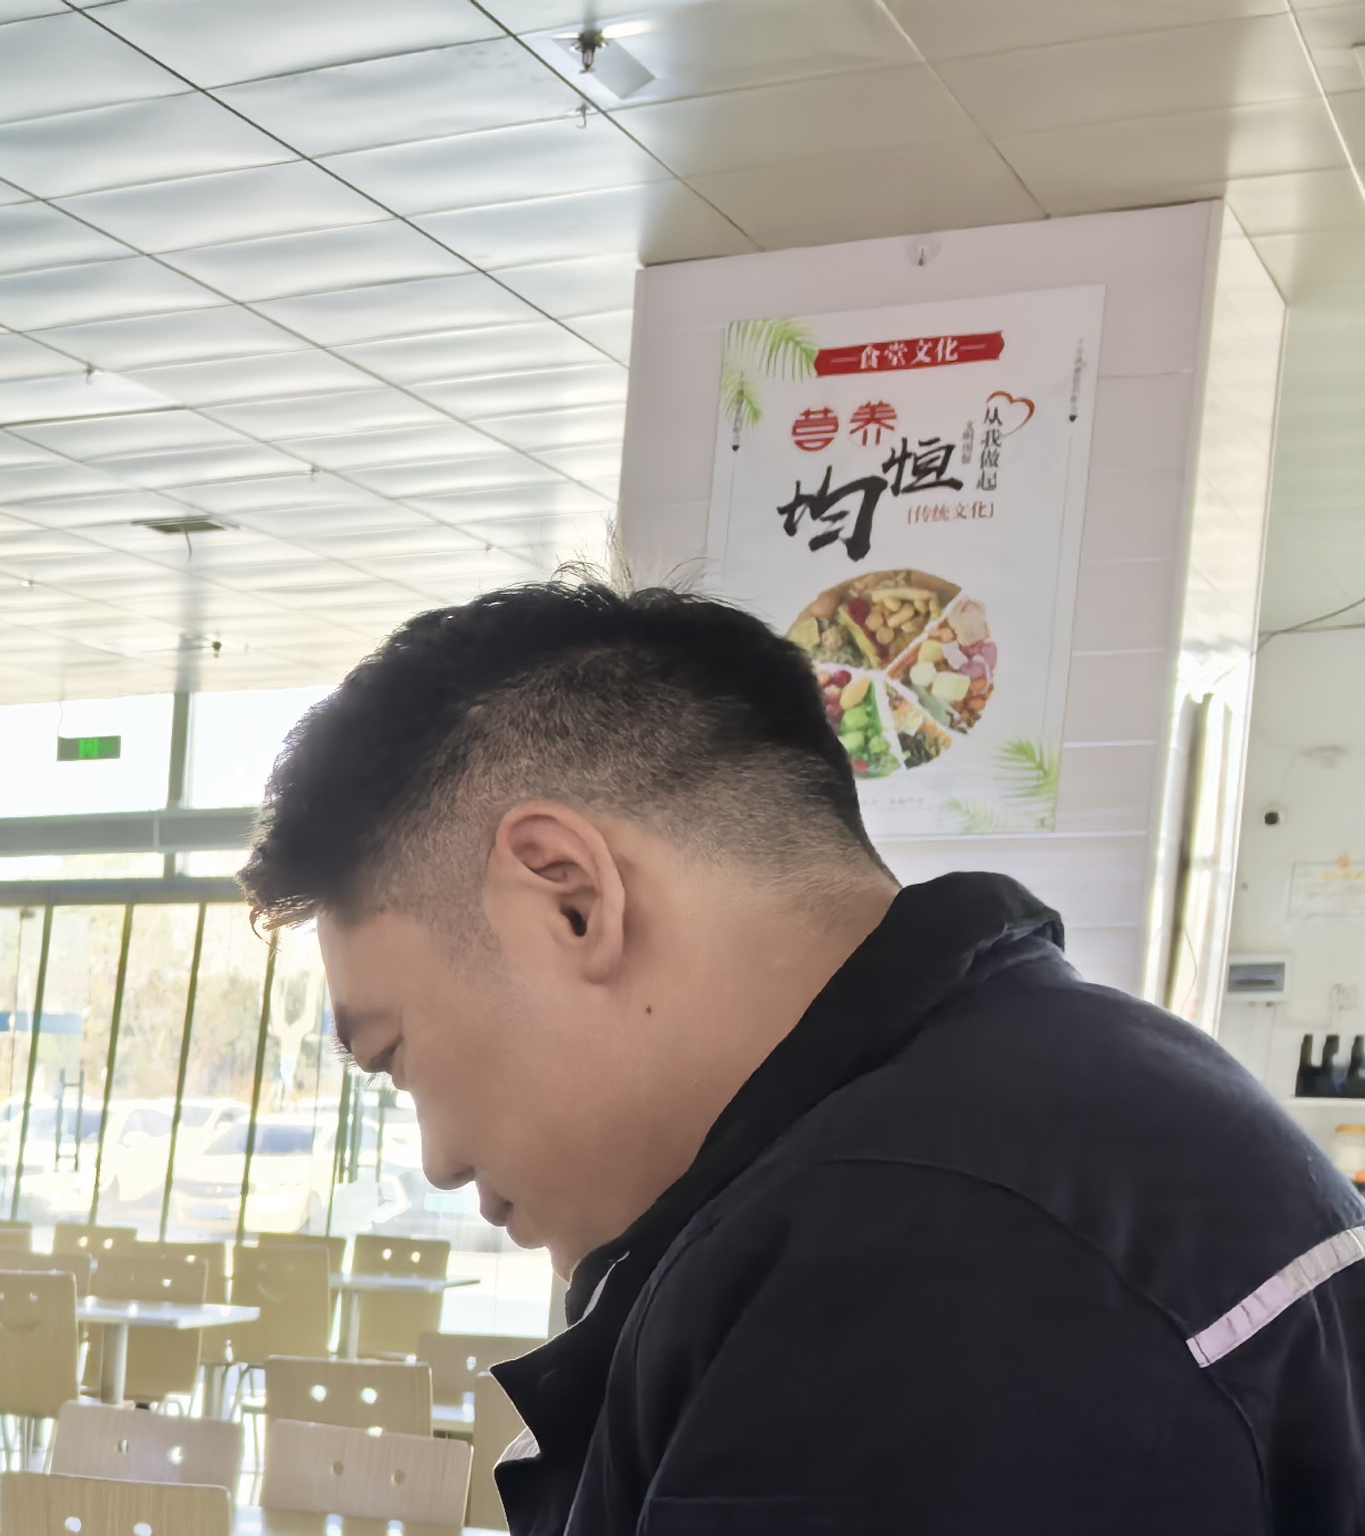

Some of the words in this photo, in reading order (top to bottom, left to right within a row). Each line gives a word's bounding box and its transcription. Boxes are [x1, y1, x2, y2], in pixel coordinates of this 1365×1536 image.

[859, 336, 959, 369] 食堂文化
[792, 400, 898, 452] 营养
[975, 406, 1003, 491] 从我做起
